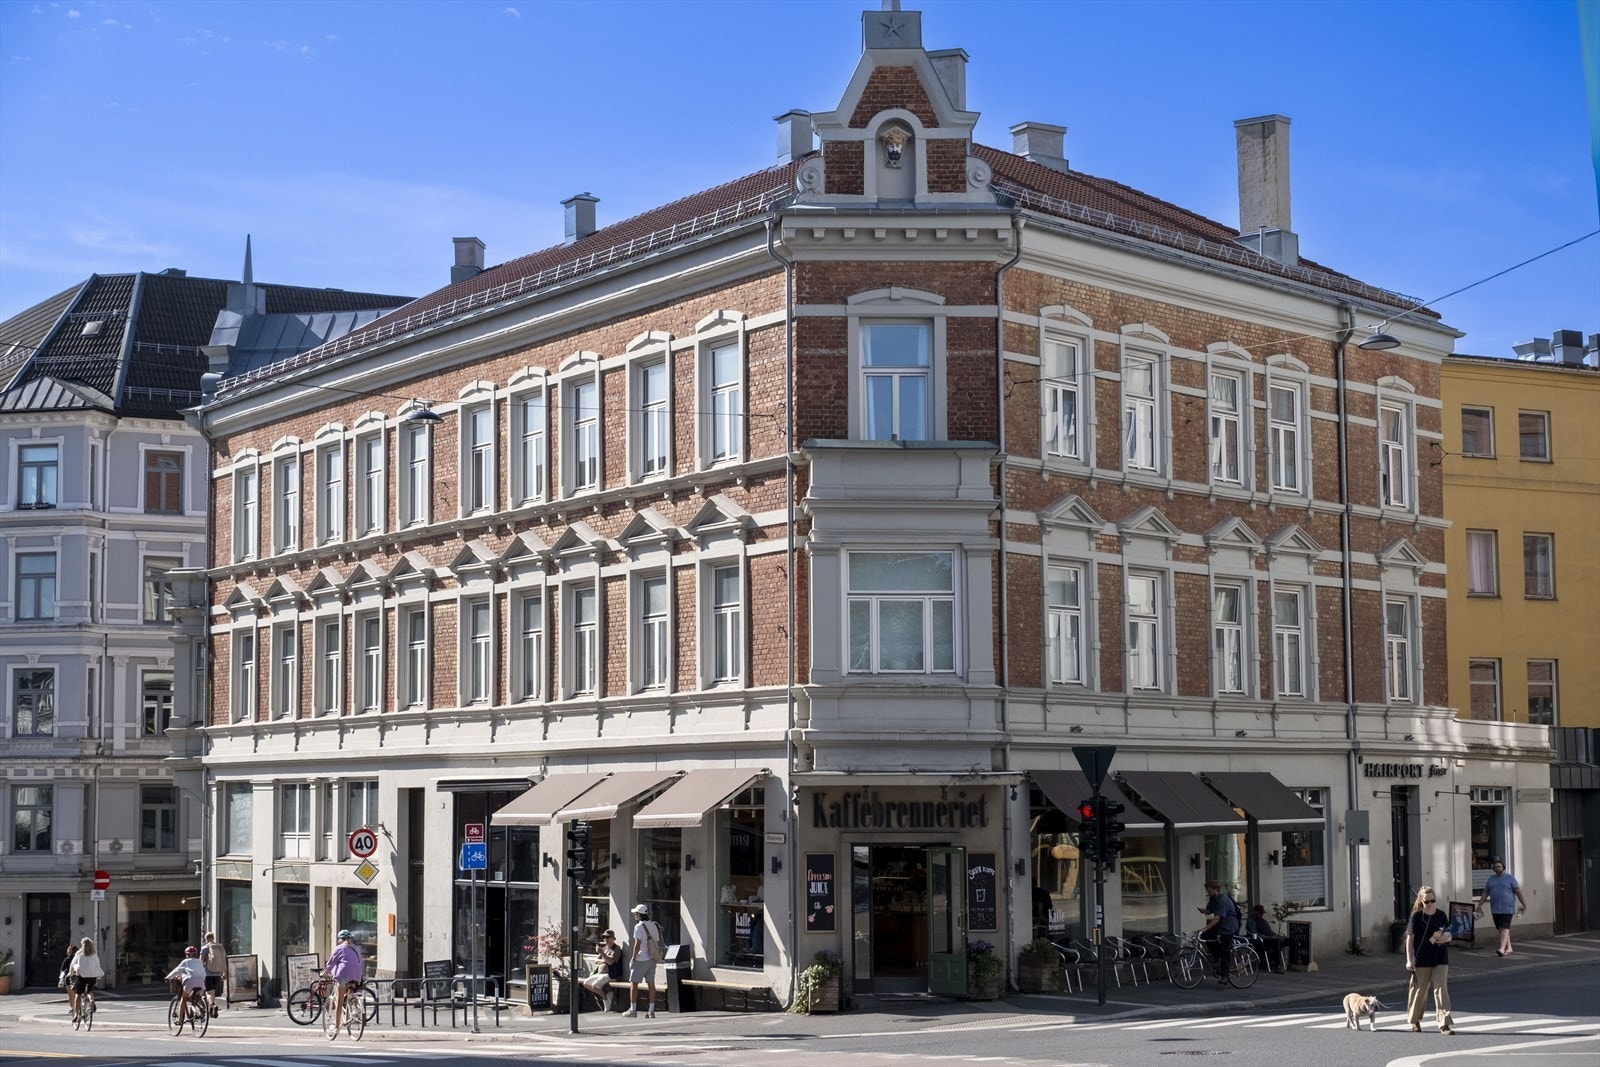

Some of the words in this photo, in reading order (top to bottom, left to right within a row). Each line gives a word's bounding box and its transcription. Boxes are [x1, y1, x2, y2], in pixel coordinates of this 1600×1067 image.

[1364, 763, 1424, 777] HAIRPORT
[812, 792, 989, 828] Kaffebrenneriet
[355, 836, 373, 850] 40
[810, 882, 829, 894] JUICE
[586, 903, 599, 917] Kaffe
[1049, 909, 1065, 923] Kaffe
[735, 912, 751, 927] Kaffe
